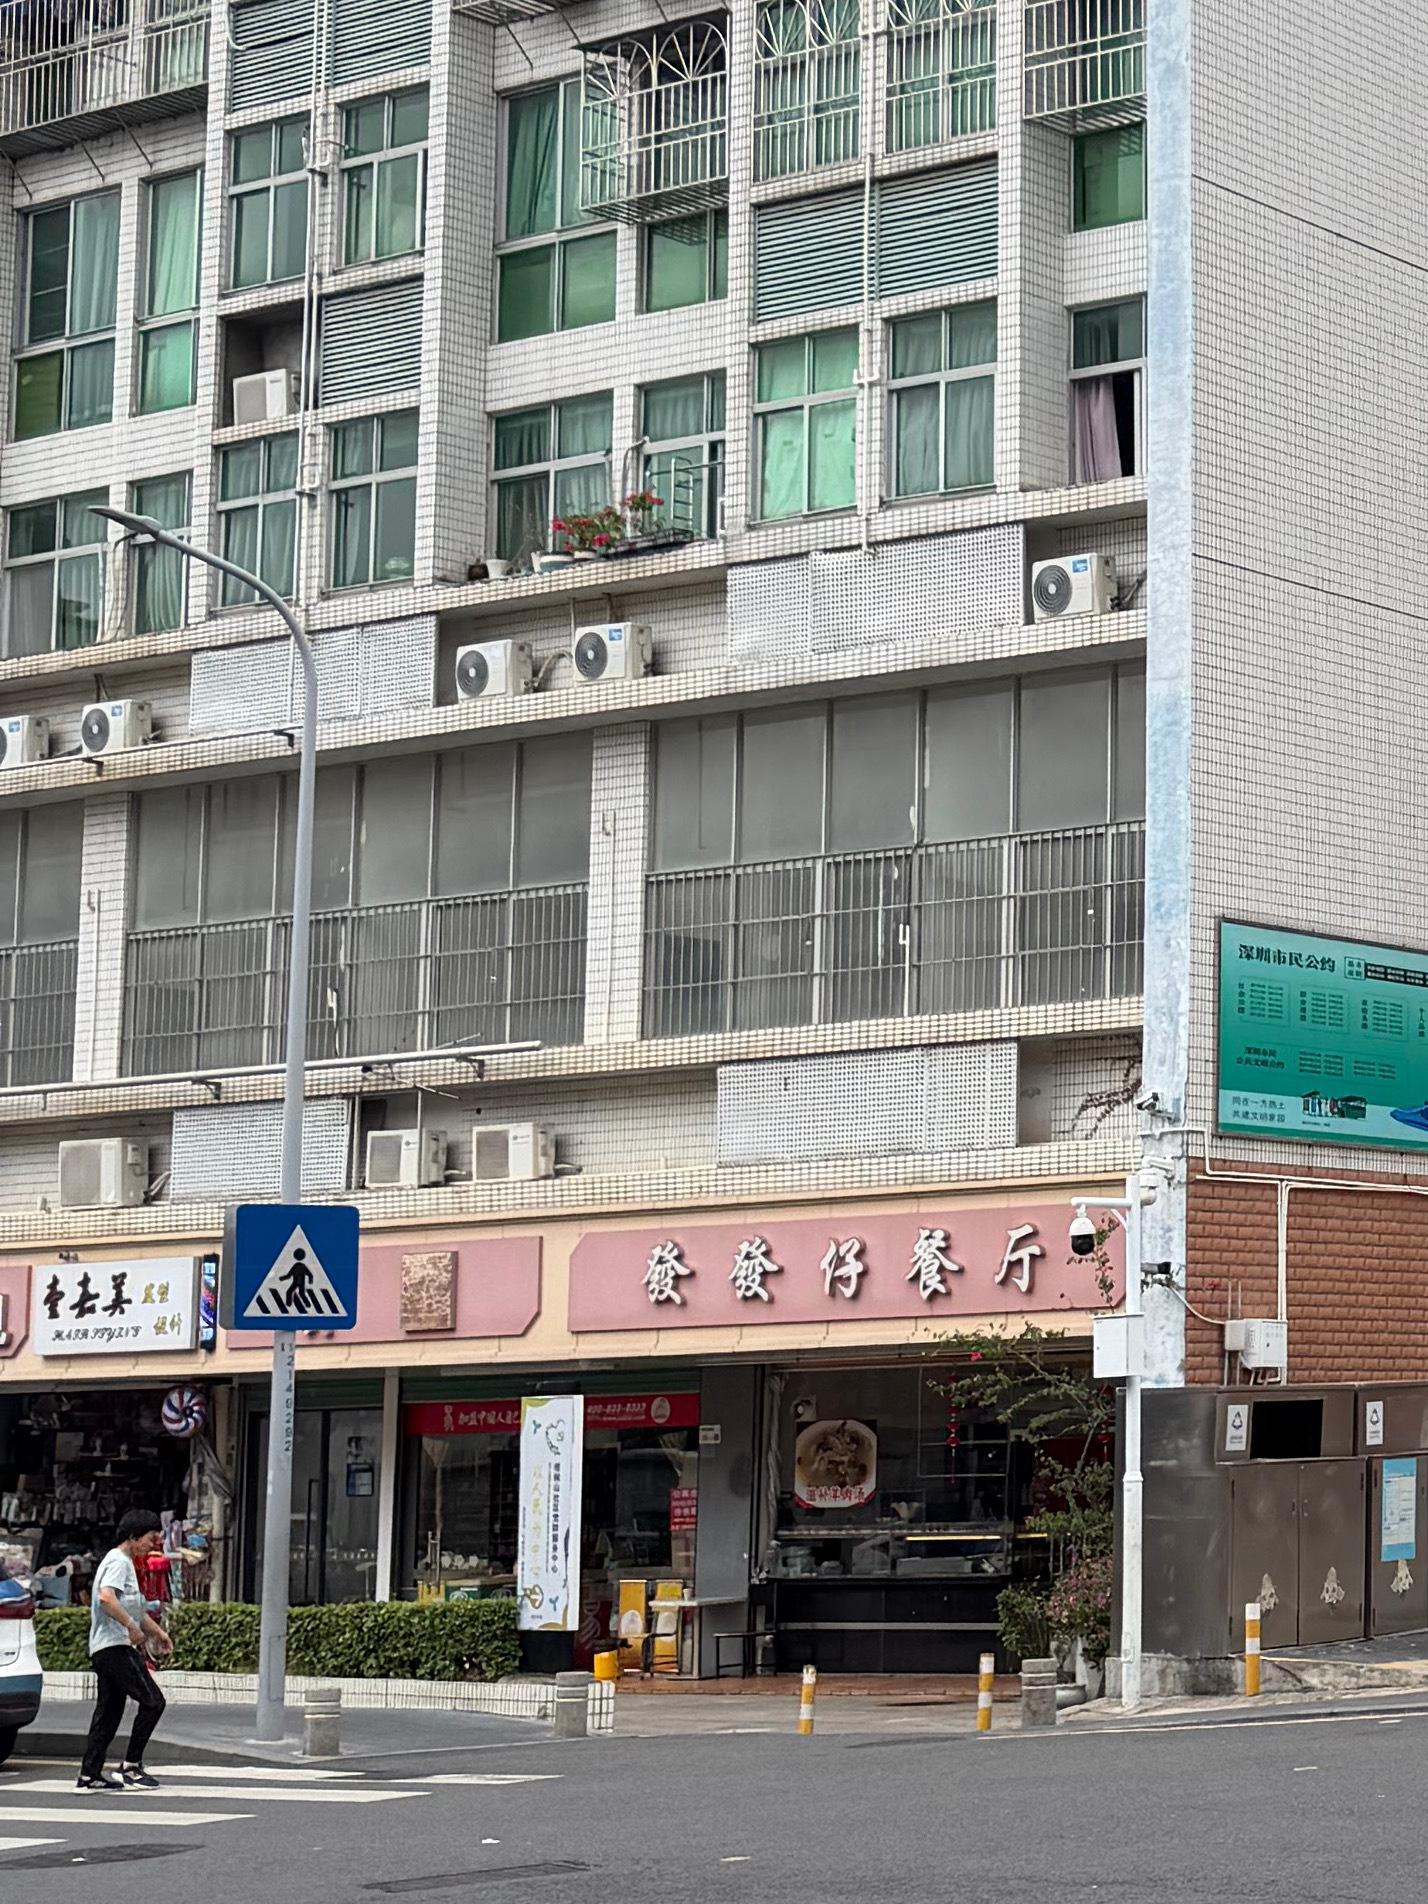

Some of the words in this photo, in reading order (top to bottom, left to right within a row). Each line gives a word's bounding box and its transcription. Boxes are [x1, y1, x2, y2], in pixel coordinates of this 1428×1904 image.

[1239, 944, 1335, 972] 深圳市民公约
[641, 1223, 1044, 1306] 發發仔餐厅
